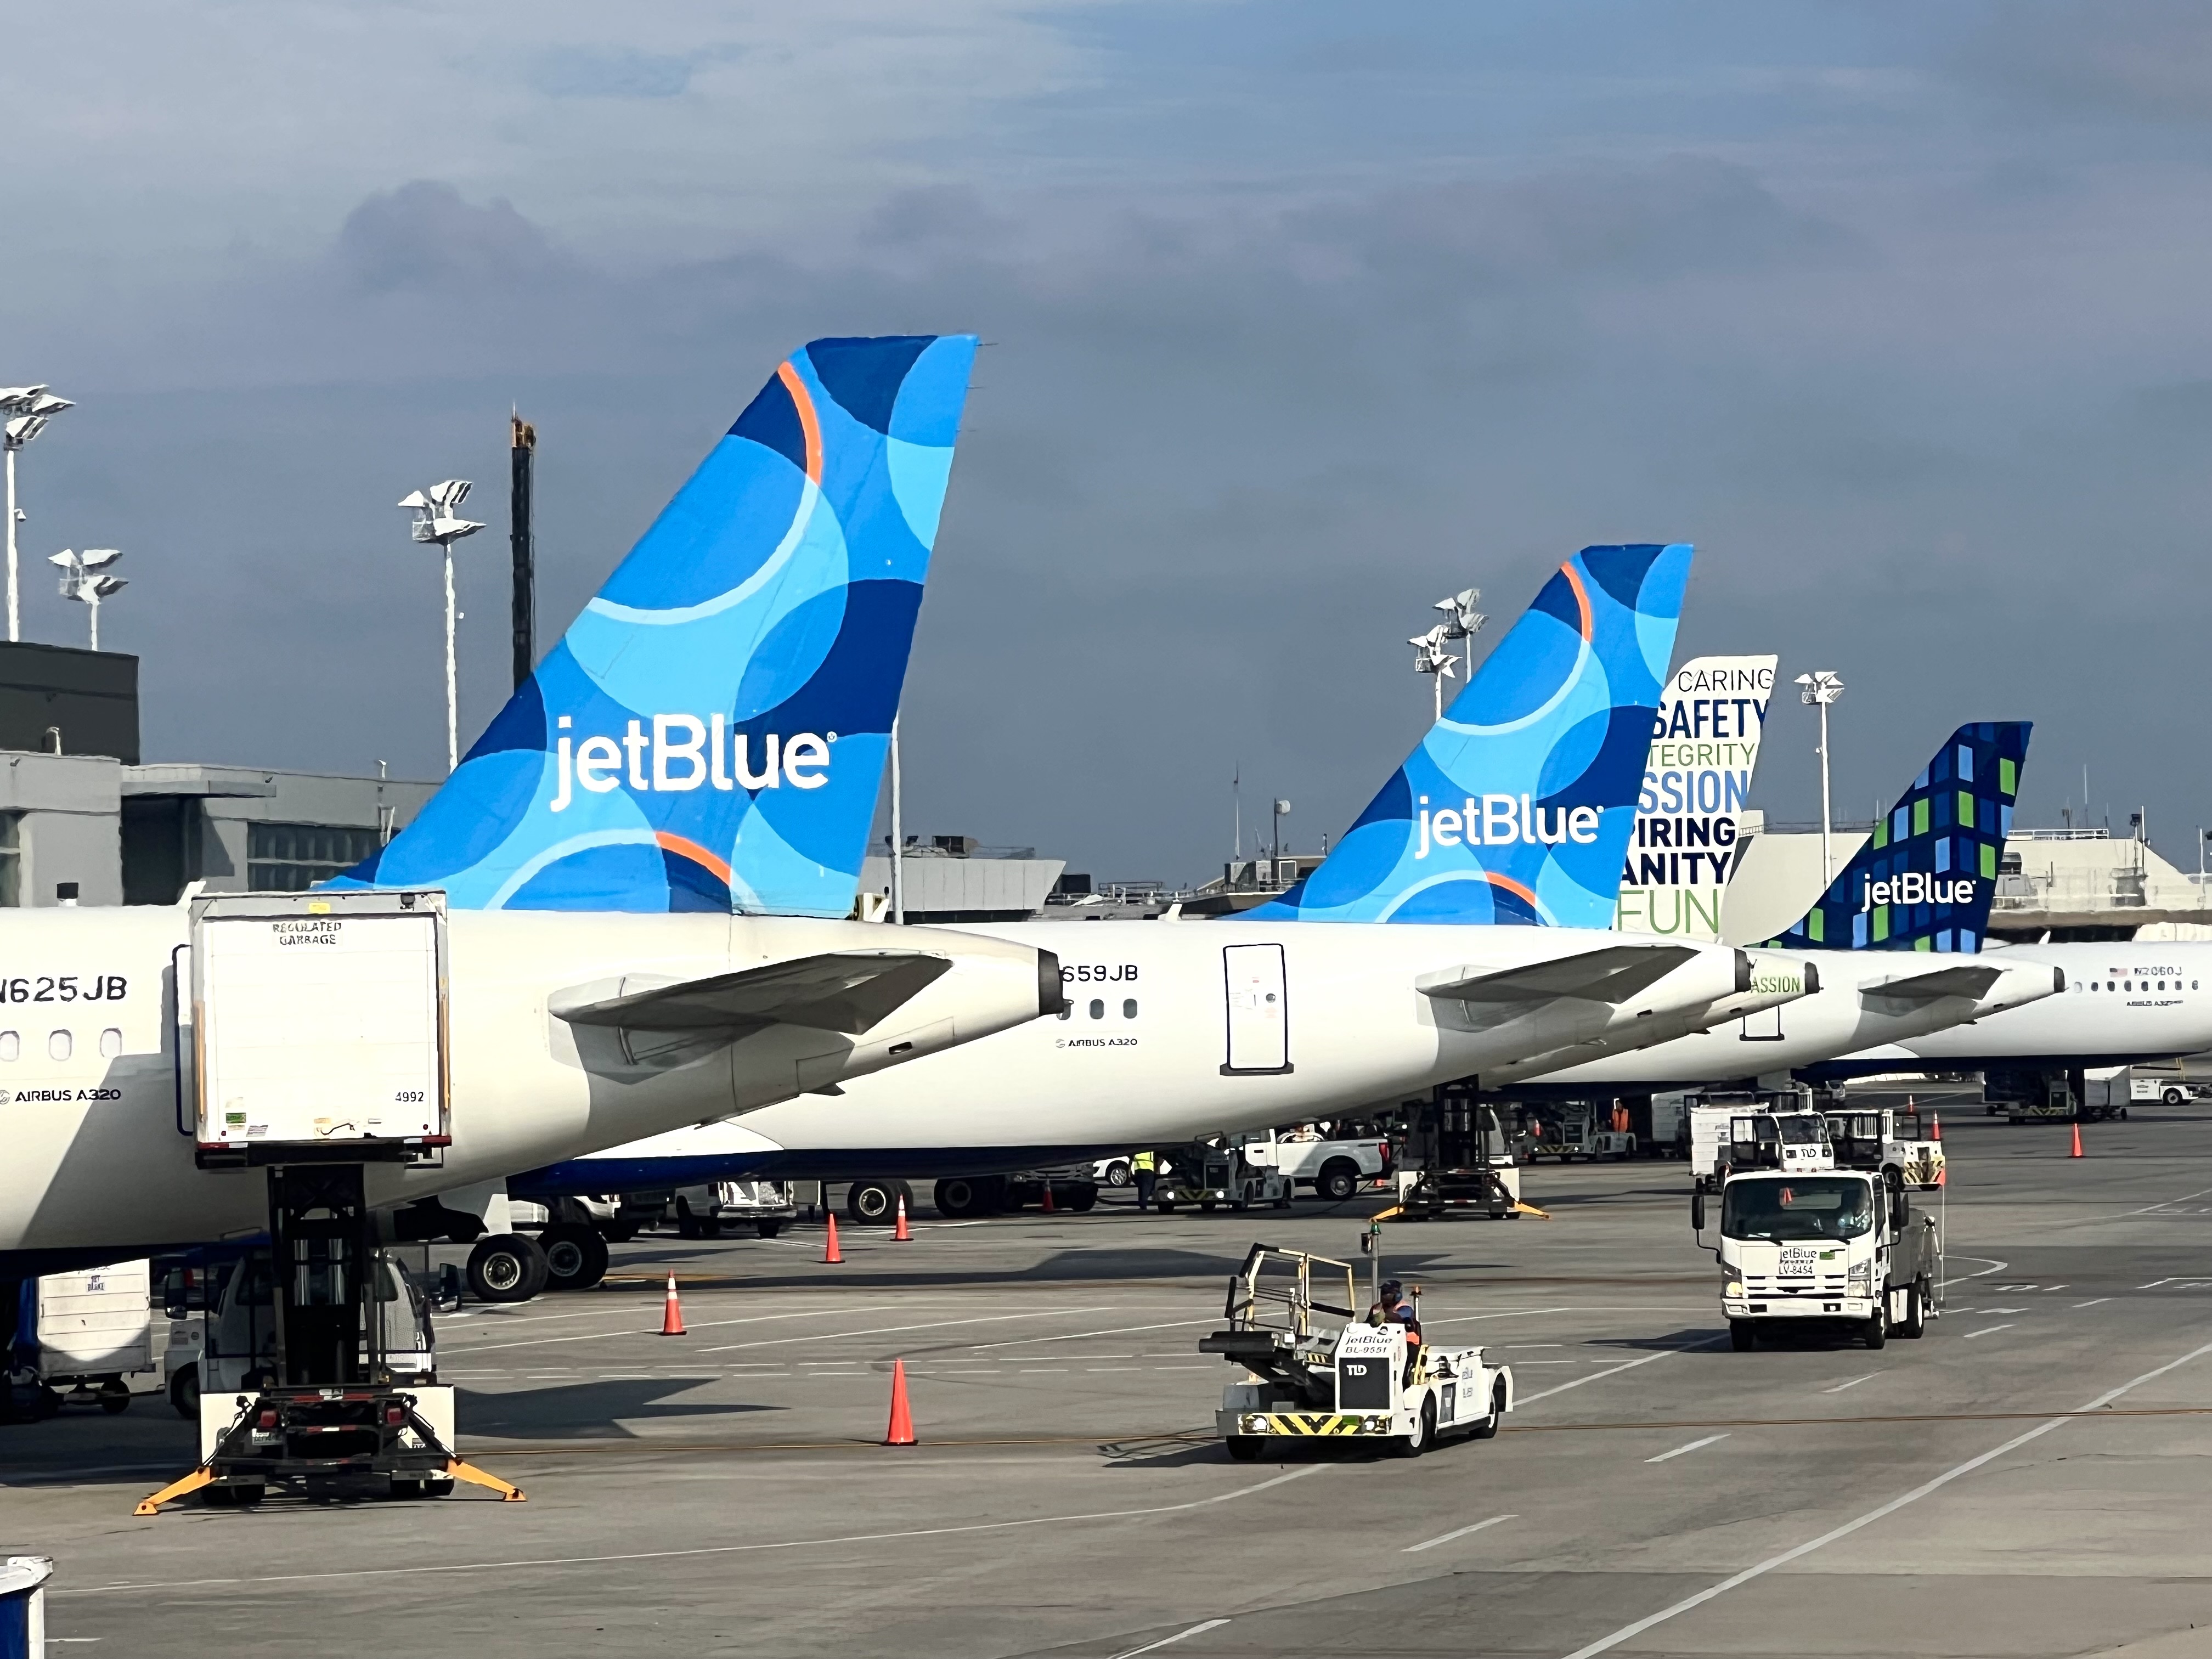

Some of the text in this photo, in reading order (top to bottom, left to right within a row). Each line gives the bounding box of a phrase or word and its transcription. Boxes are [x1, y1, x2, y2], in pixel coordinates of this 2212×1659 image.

[1678, 669, 1774, 692] CARING
[550, 713, 830, 812] jetBlue
[1415, 793, 1599, 859] jetBlue
[1633, 817, 1735, 847] IRING
[1861, 872, 1973, 912] jetBlue
[1618, 889, 1719, 934] FUN
[273, 922, 341, 933] REGULATED
[280, 934, 336, 945] GARBAGE
[15, 1089, 121, 1102] AIRBUS A320
[395, 1091, 424, 1102] 4992
[1346, 1364, 1367, 1376] TLD
